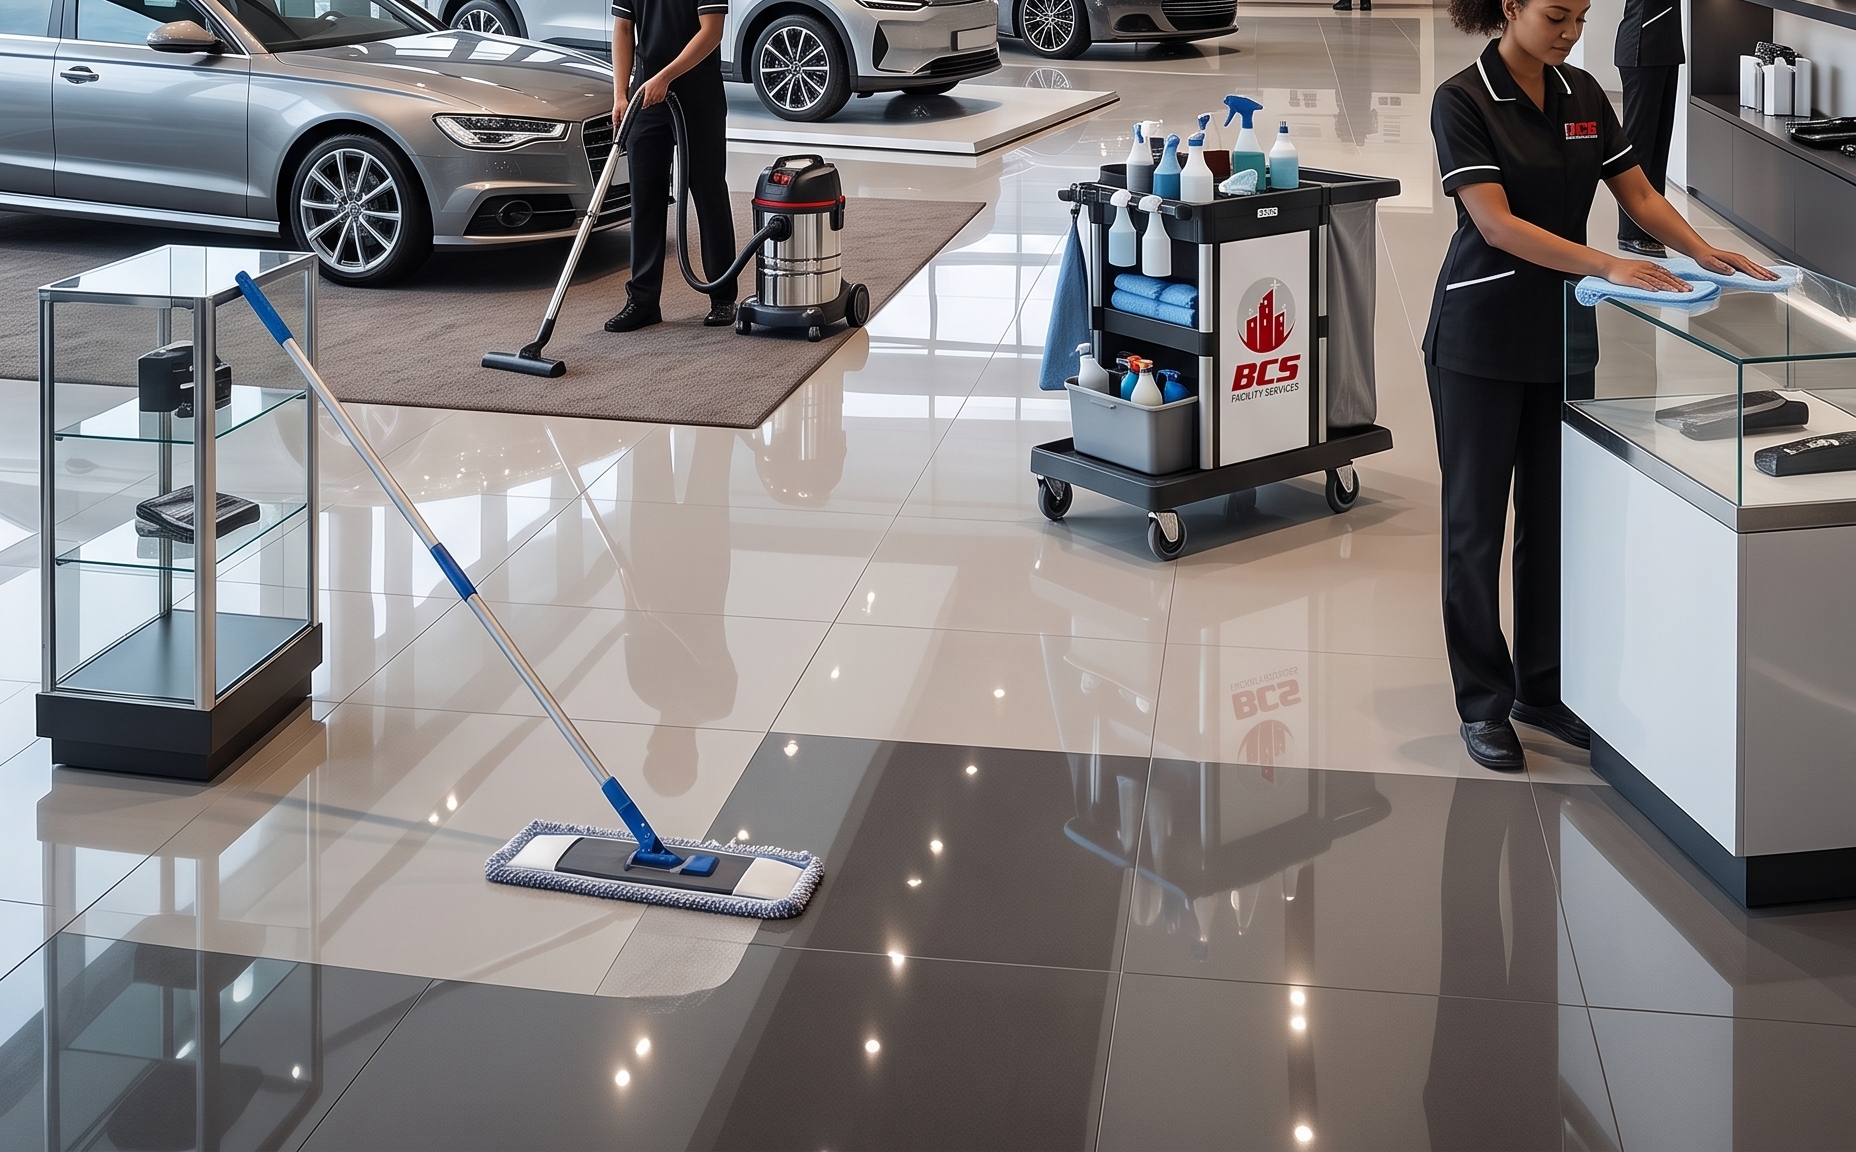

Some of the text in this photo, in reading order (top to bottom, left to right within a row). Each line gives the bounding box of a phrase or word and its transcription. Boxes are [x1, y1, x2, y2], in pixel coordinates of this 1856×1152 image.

[1231, 354, 1301, 392] BCS
[1231, 383, 1299, 403] FACILITY SERVICES
